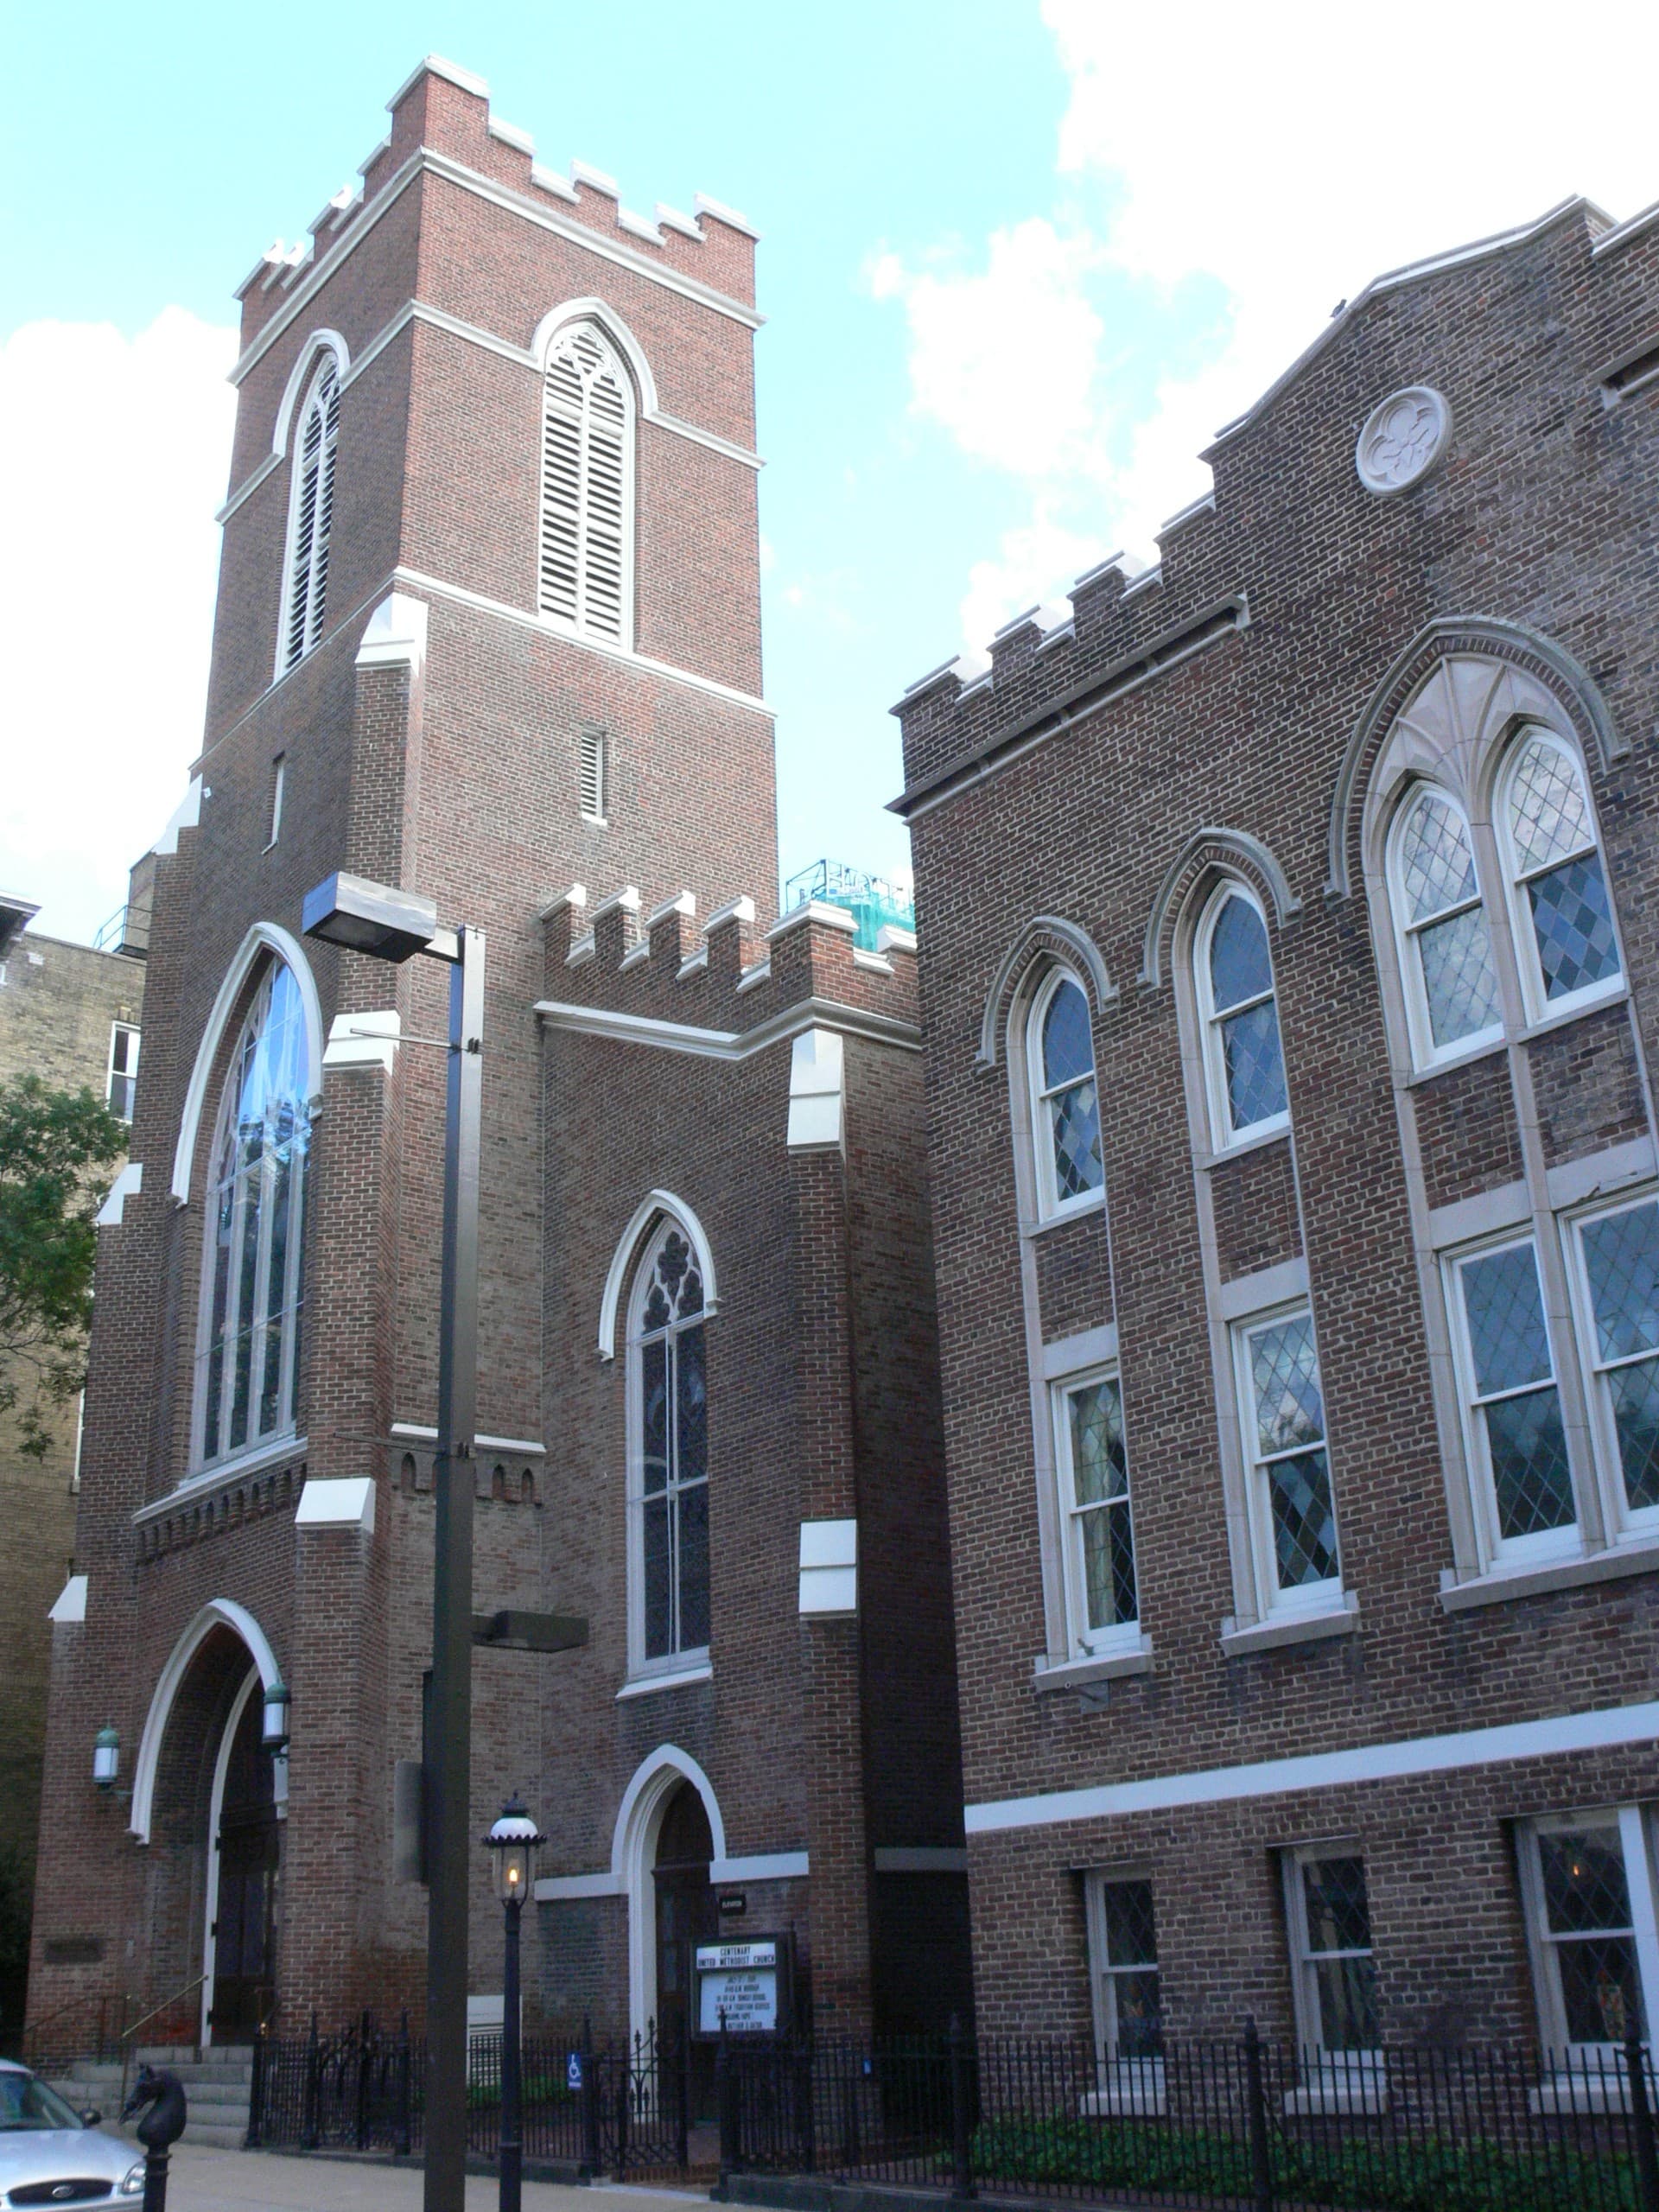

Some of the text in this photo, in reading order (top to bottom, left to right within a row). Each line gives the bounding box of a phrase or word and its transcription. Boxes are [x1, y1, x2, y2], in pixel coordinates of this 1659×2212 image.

[720, 1946, 751, 1956] CENTENARY
[698, 1955, 775, 1967] UNITED METHODIST CHURCH
